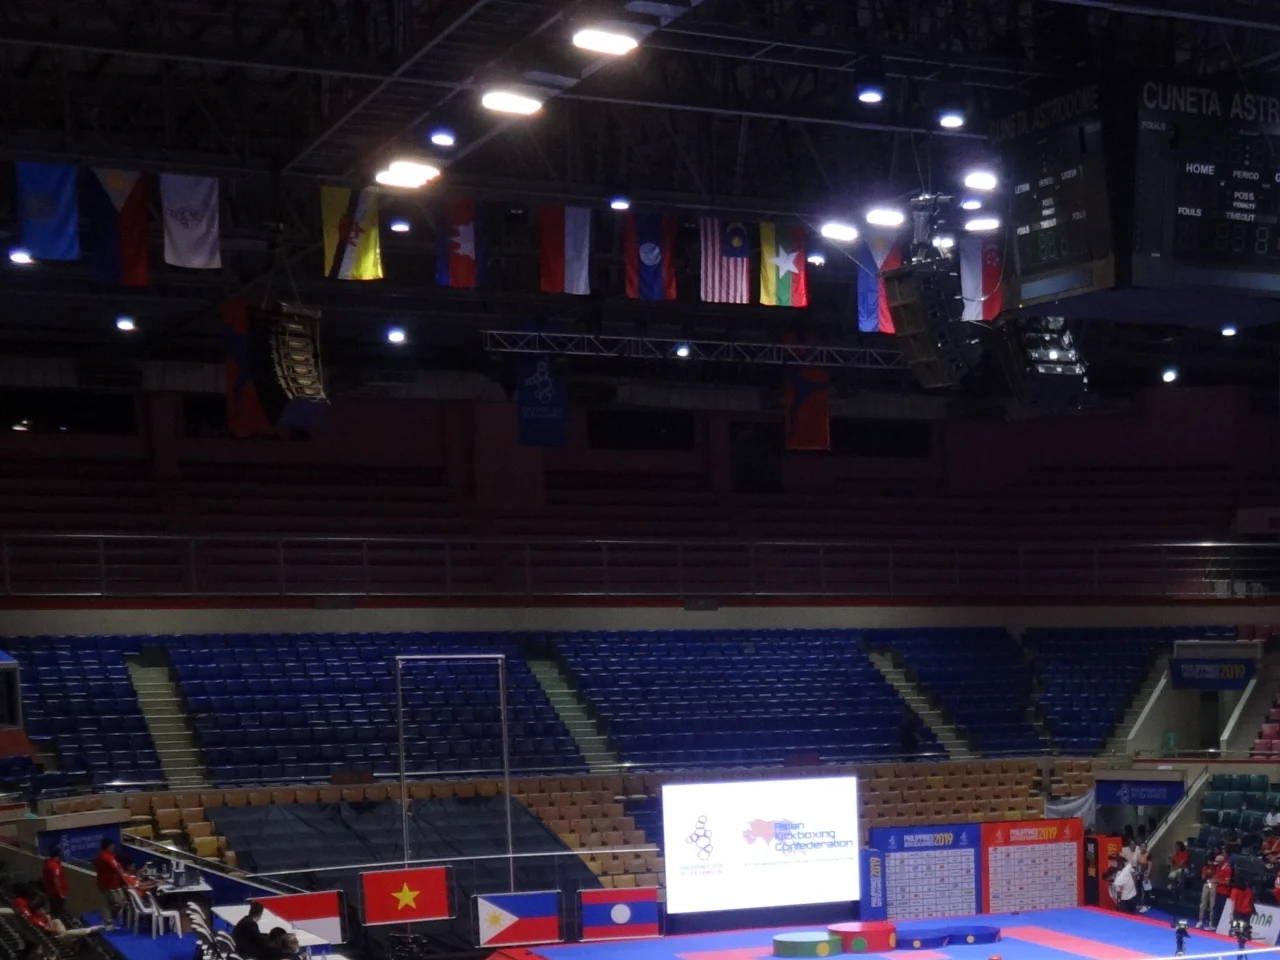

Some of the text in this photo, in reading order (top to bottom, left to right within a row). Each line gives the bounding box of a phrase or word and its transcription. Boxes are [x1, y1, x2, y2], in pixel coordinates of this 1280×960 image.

[1143, 81, 1221, 116] CUNETA
[1186, 163, 1215, 175] HOME
[1233, 170, 1259, 181] PERIOD
[1178, 206, 1202, 217] FOULS
[1226, 211, 1256, 222] TIMEOUT
[1038, 826, 1058, 840] 2019
[775, 839, 854, 852] Confederation
[934, 833, 954, 846] 2019
